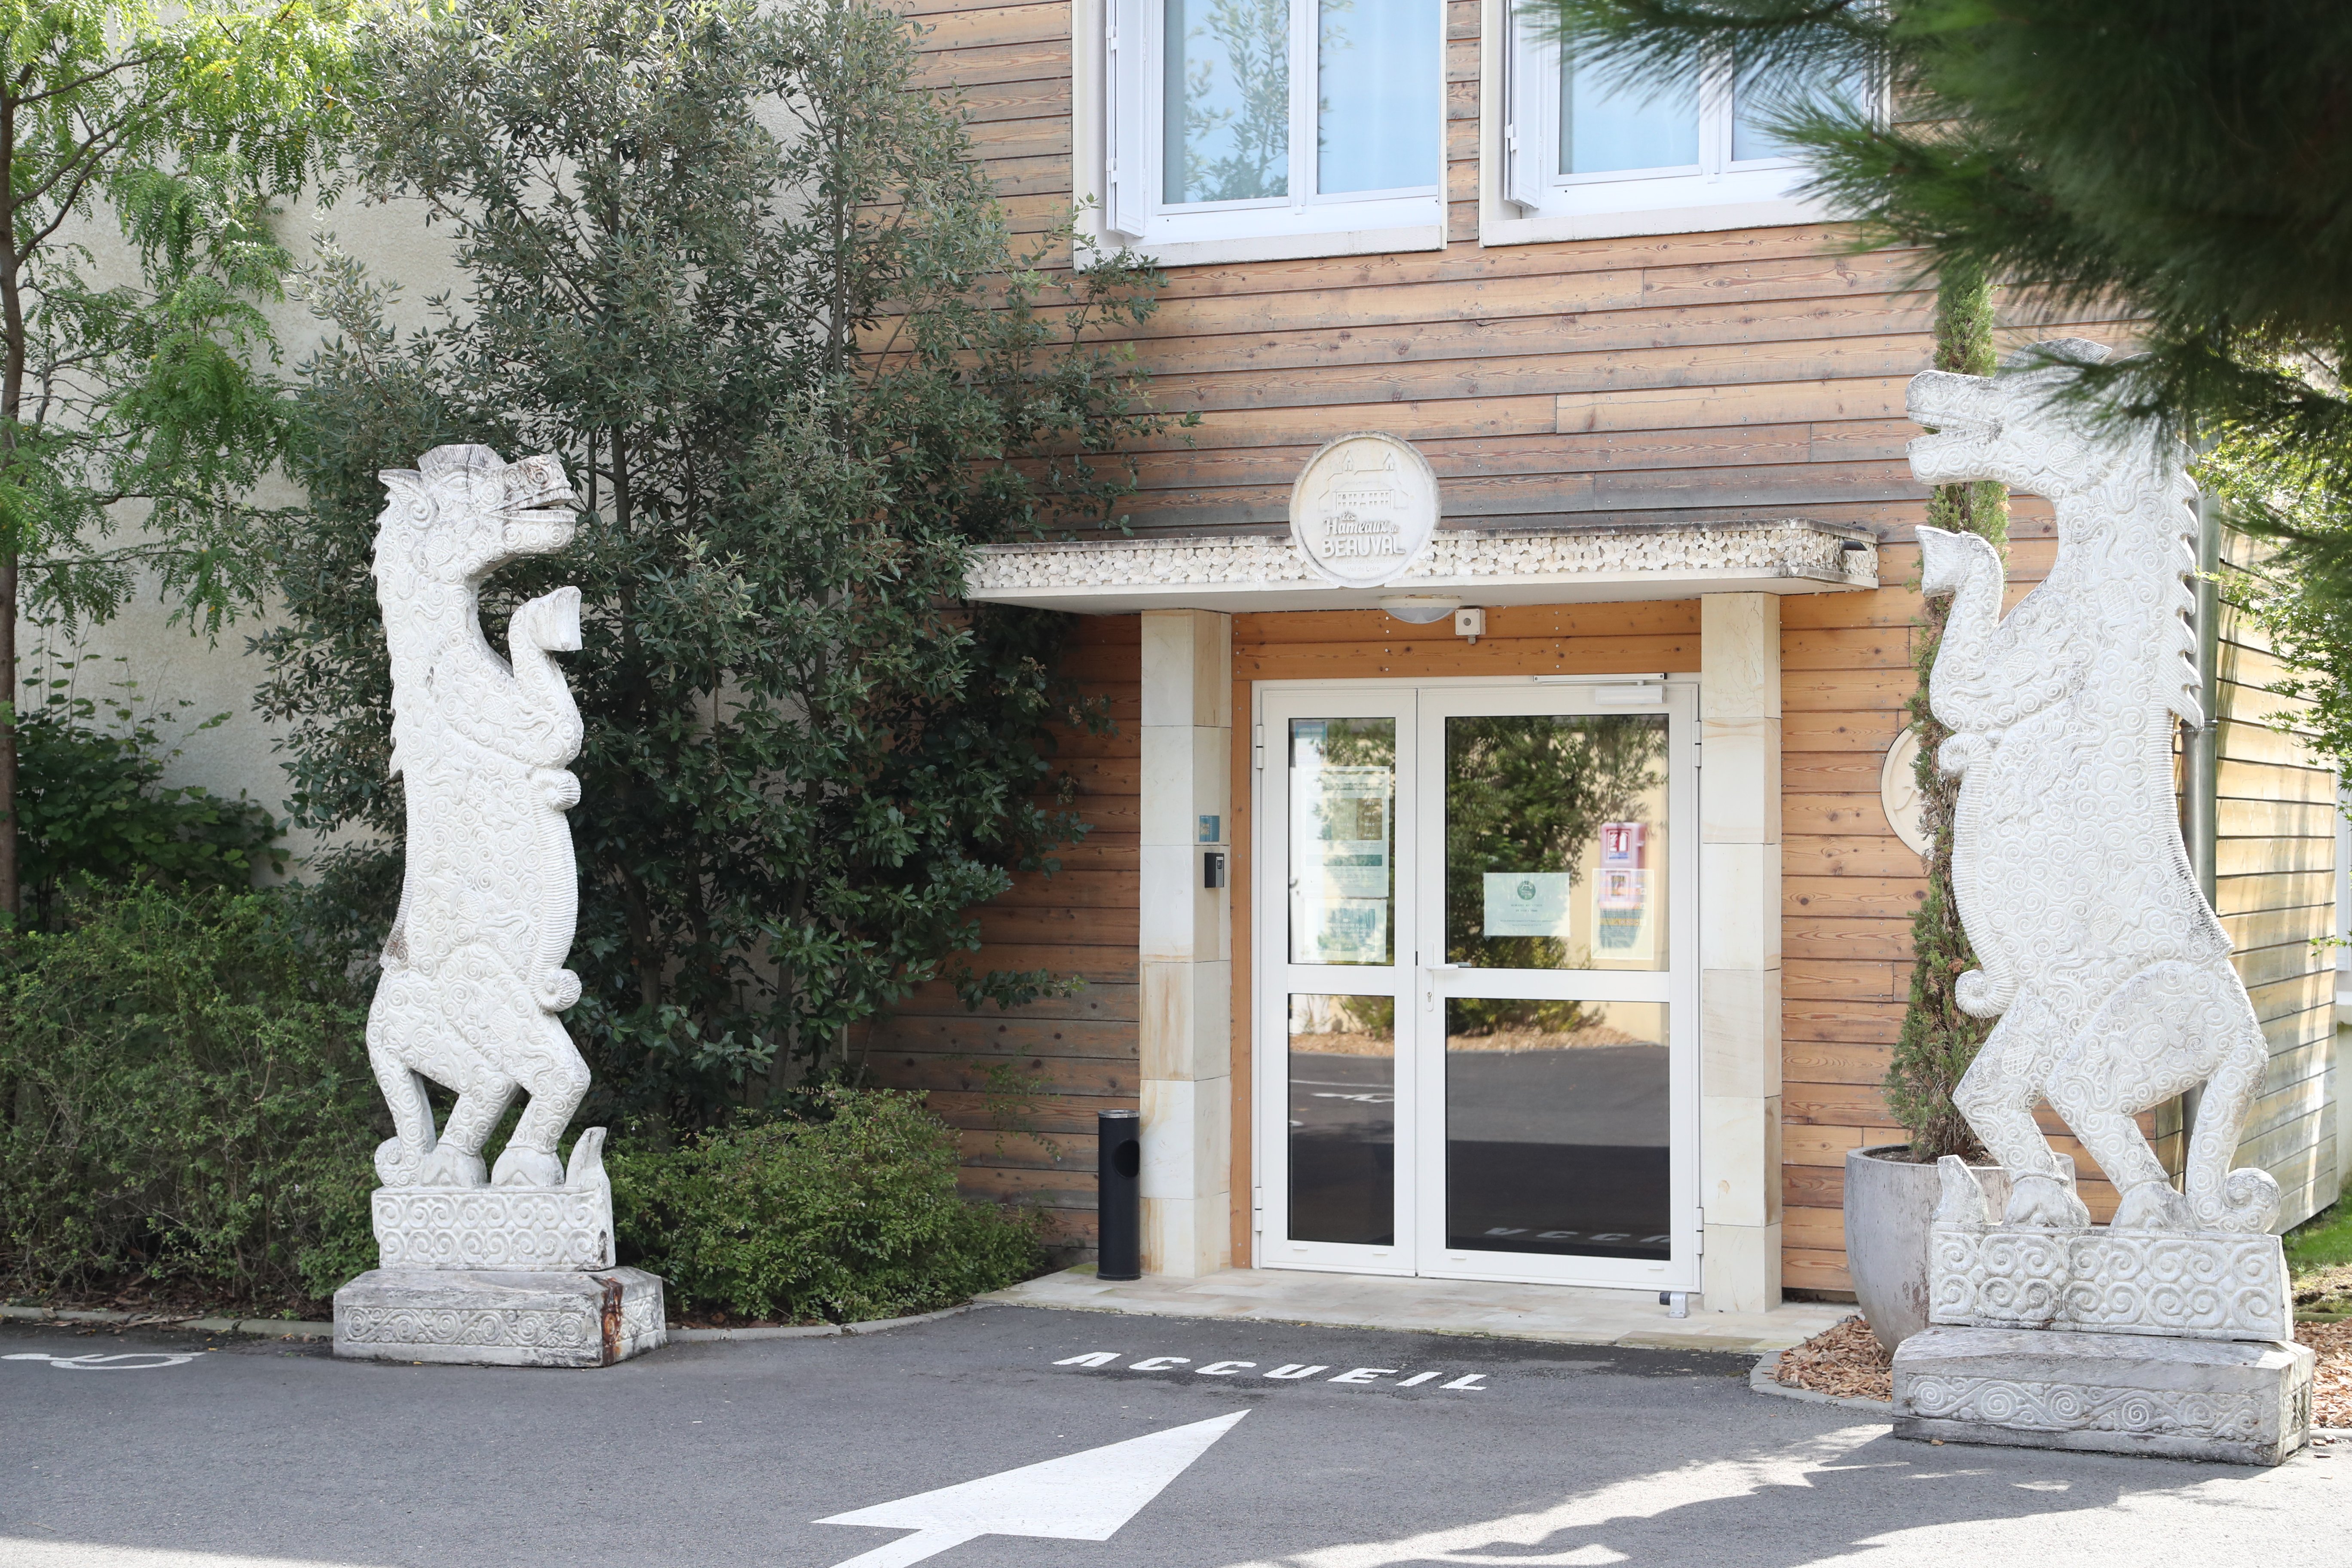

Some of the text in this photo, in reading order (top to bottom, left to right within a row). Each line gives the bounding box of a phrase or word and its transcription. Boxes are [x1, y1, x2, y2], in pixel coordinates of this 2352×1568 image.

[1322, 517, 1388, 536] Hameaux
[1341, 512, 1355, 521] Les
[1321, 535, 1406, 557] BEAUVAL
[1051, 1351, 1487, 1391] ACCUEIL
